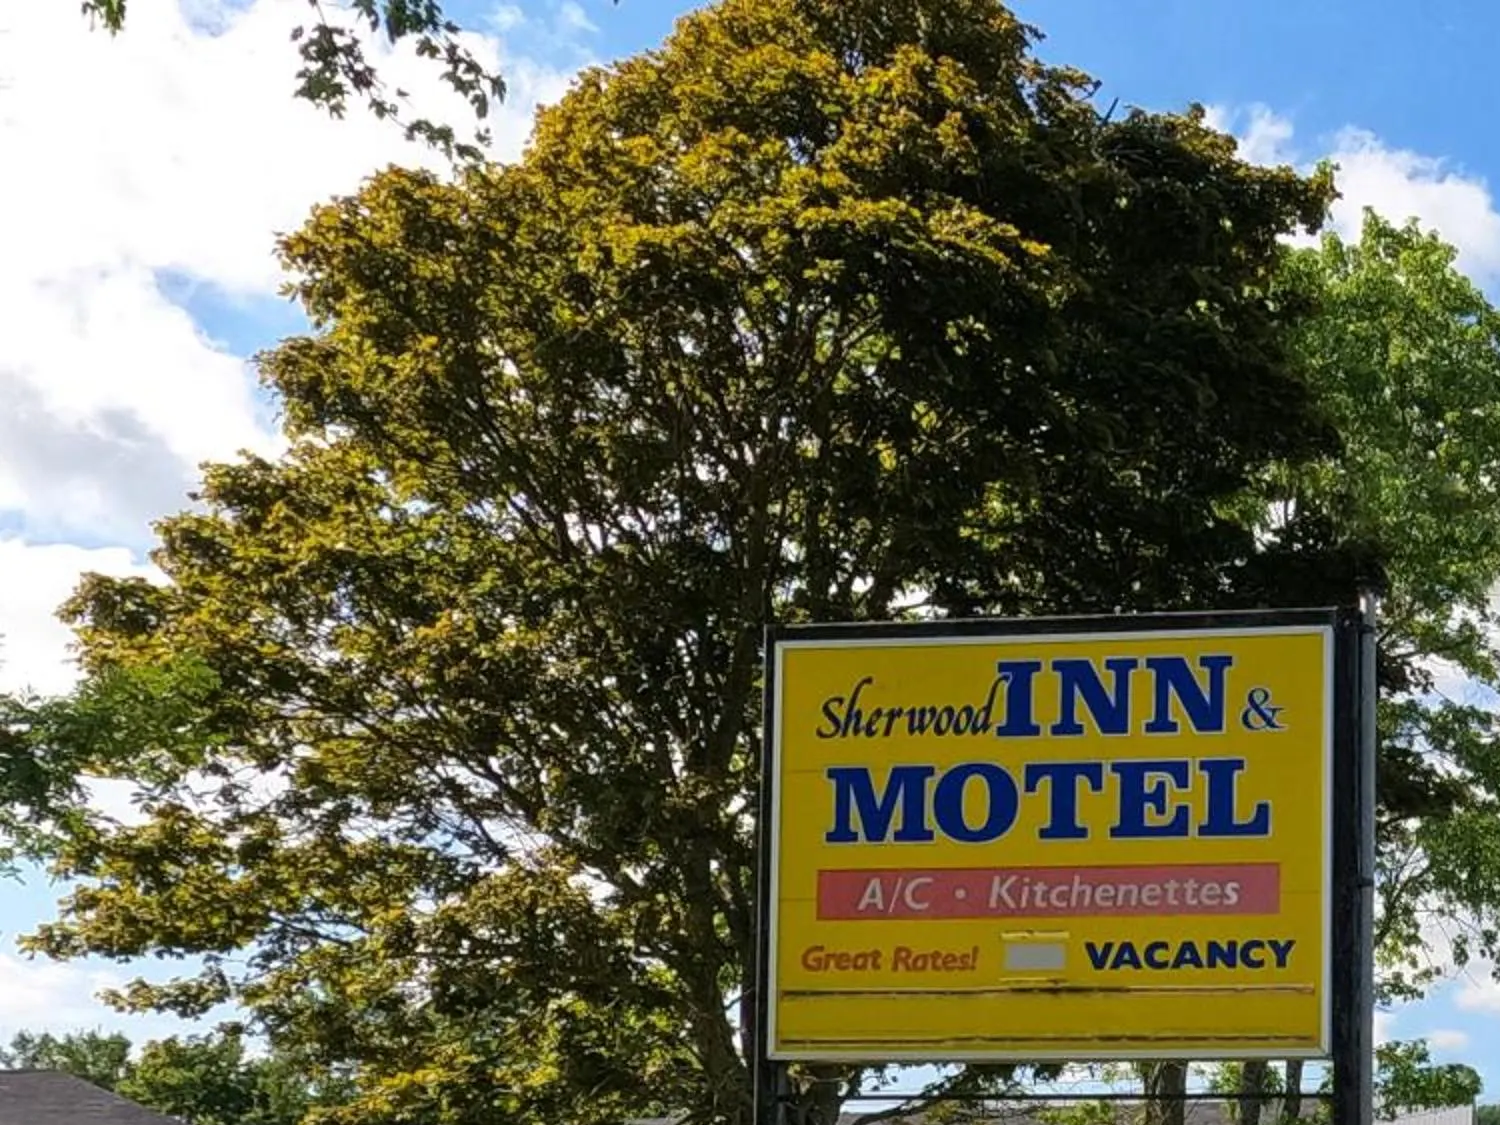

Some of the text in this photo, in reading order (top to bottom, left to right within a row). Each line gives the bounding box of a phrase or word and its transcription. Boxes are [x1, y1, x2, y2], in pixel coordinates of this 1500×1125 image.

[815, 656, 1284, 739] Sherwood INN &
[824, 758, 1272, 844] MOTEL
[857, 875, 1241, 912] A/C Kitchenettes
[800, 945, 979, 973] Great Rates!
[1085, 939, 1296, 971] VACANCY
